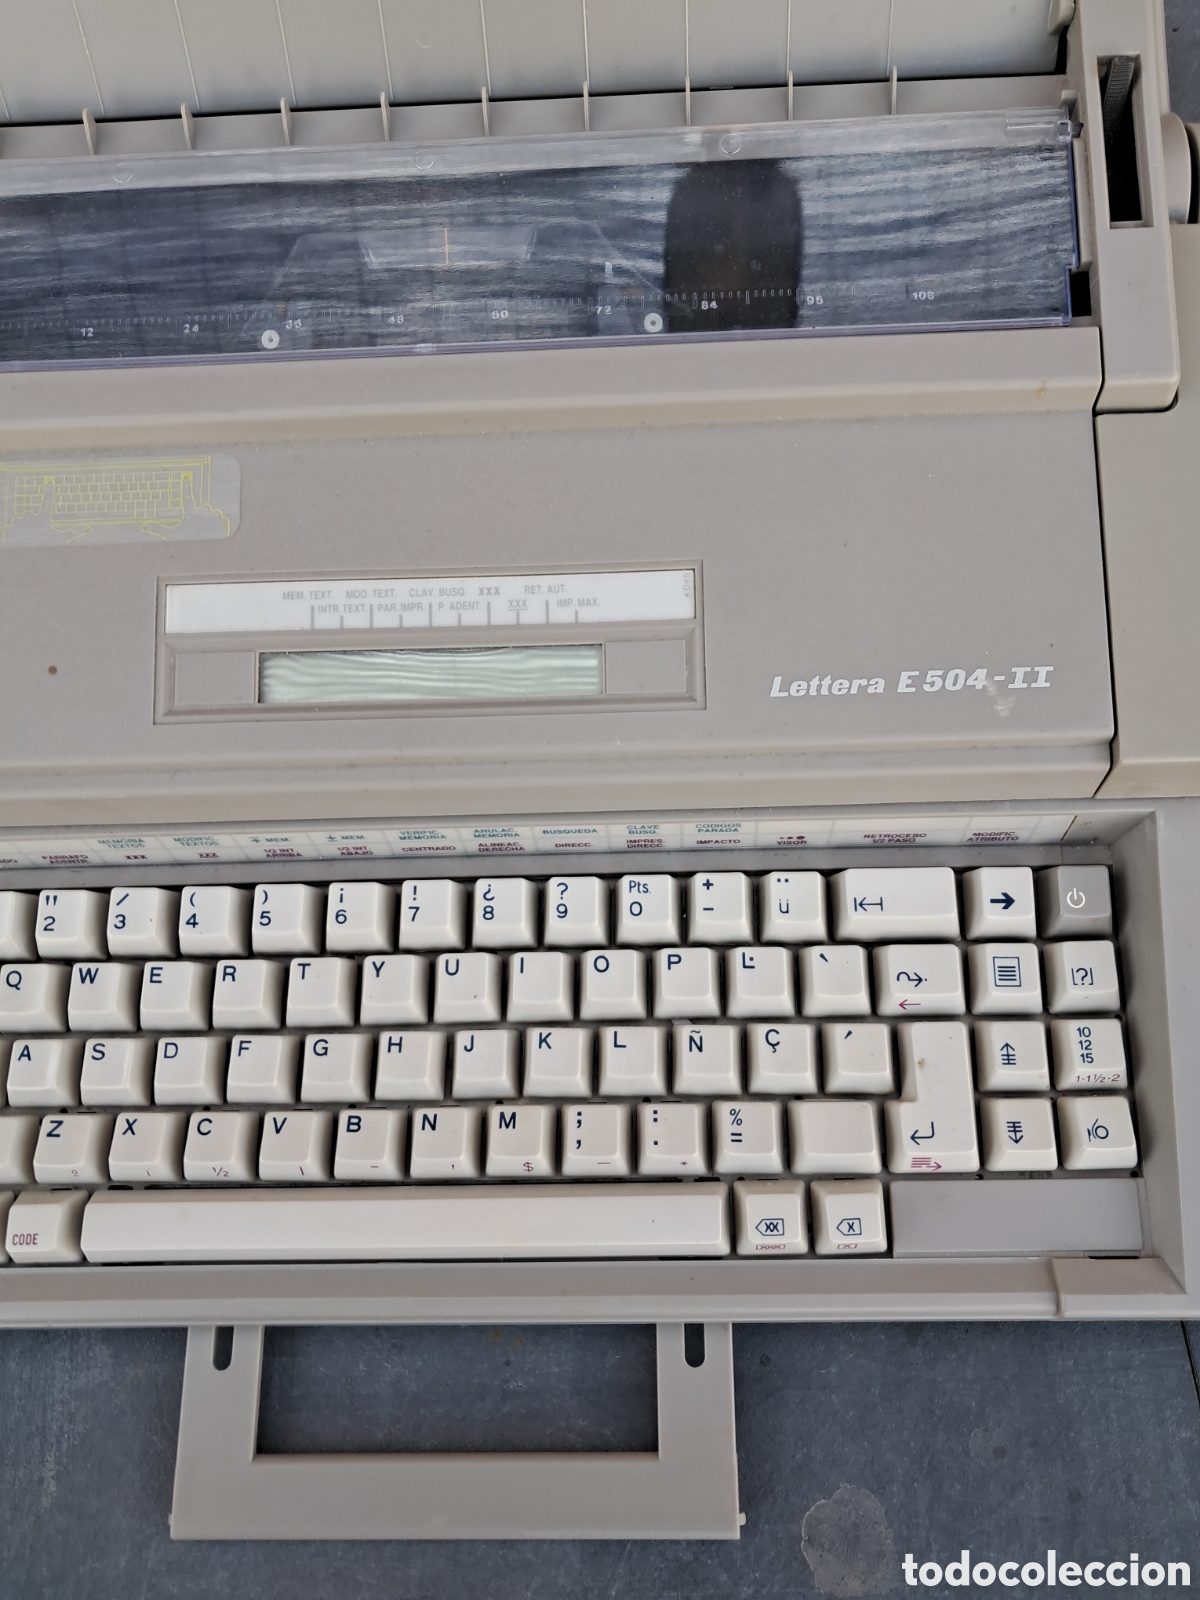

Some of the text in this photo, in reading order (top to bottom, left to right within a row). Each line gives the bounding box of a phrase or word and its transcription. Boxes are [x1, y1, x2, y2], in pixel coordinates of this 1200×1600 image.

[80, 327, 94, 337] 12
[183, 323, 200, 334] 24
[595, 305, 612, 315] 72
[701, 300, 718, 310] 84
[806, 295, 823, 306] 96
[282, 591, 306, 601] MEM.
[308, 590, 334, 600] TEXT.
[345, 590, 370, 599] MOD.
[372, 589, 398, 599] TEXT.
[478, 587, 501, 596] XXX
[507, 599, 528, 611] XXX
[770, 675, 885, 697] Lettera
[863, 832, 927, 840] RETROCESO
[259, 911, 271, 926] 5
[335, 909, 347, 924] 6
[409, 907, 419, 921] 7
[483, 905, 494, 920] 8
[556, 904, 568, 918] 9
[43, 916, 55, 931] 2
[114, 914, 126, 929] 3
[186, 913, 199, 928] 4
[372, 961, 385, 977] Y
[445, 959, 459, 976] U
[594, 955, 609, 973] O
[668, 954, 681, 970] P
[79, 968, 99, 984] W
[150, 967, 163, 983] E
[223, 966, 236, 982] R
[298, 963, 311, 979] T
[6, 971, 22, 990] Q
[614, 1031, 626, 1048] L
[1077, 1027, 1091, 1037] 10
[238, 1040, 252, 1056] F
[313, 1039, 328, 1056] G
[388, 1036, 402, 1053] H
[464, 1035, 474, 1052] J
[539, 1032, 551, 1049] K
[689, 1030, 703, 1052] Ñ
[765, 1029, 780, 1053] Ç
[1079, 1040, 1092, 1050] 12
[18, 1045, 31, 1061] A
[91, 1043, 105, 1060] S
[164, 1042, 178, 1058] D
[1080, 1053, 1094, 1063] 15
[46, 1120, 63, 1137] Z
[123, 1119, 137, 1135] X
[197, 1118, 212, 1135] C
[273, 1117, 287, 1134] V
[347, 1116, 361, 1132] B
[422, 1114, 437, 1131] N
[499, 1112, 516, 1129] M
[12, 1233, 38, 1245] CODE
